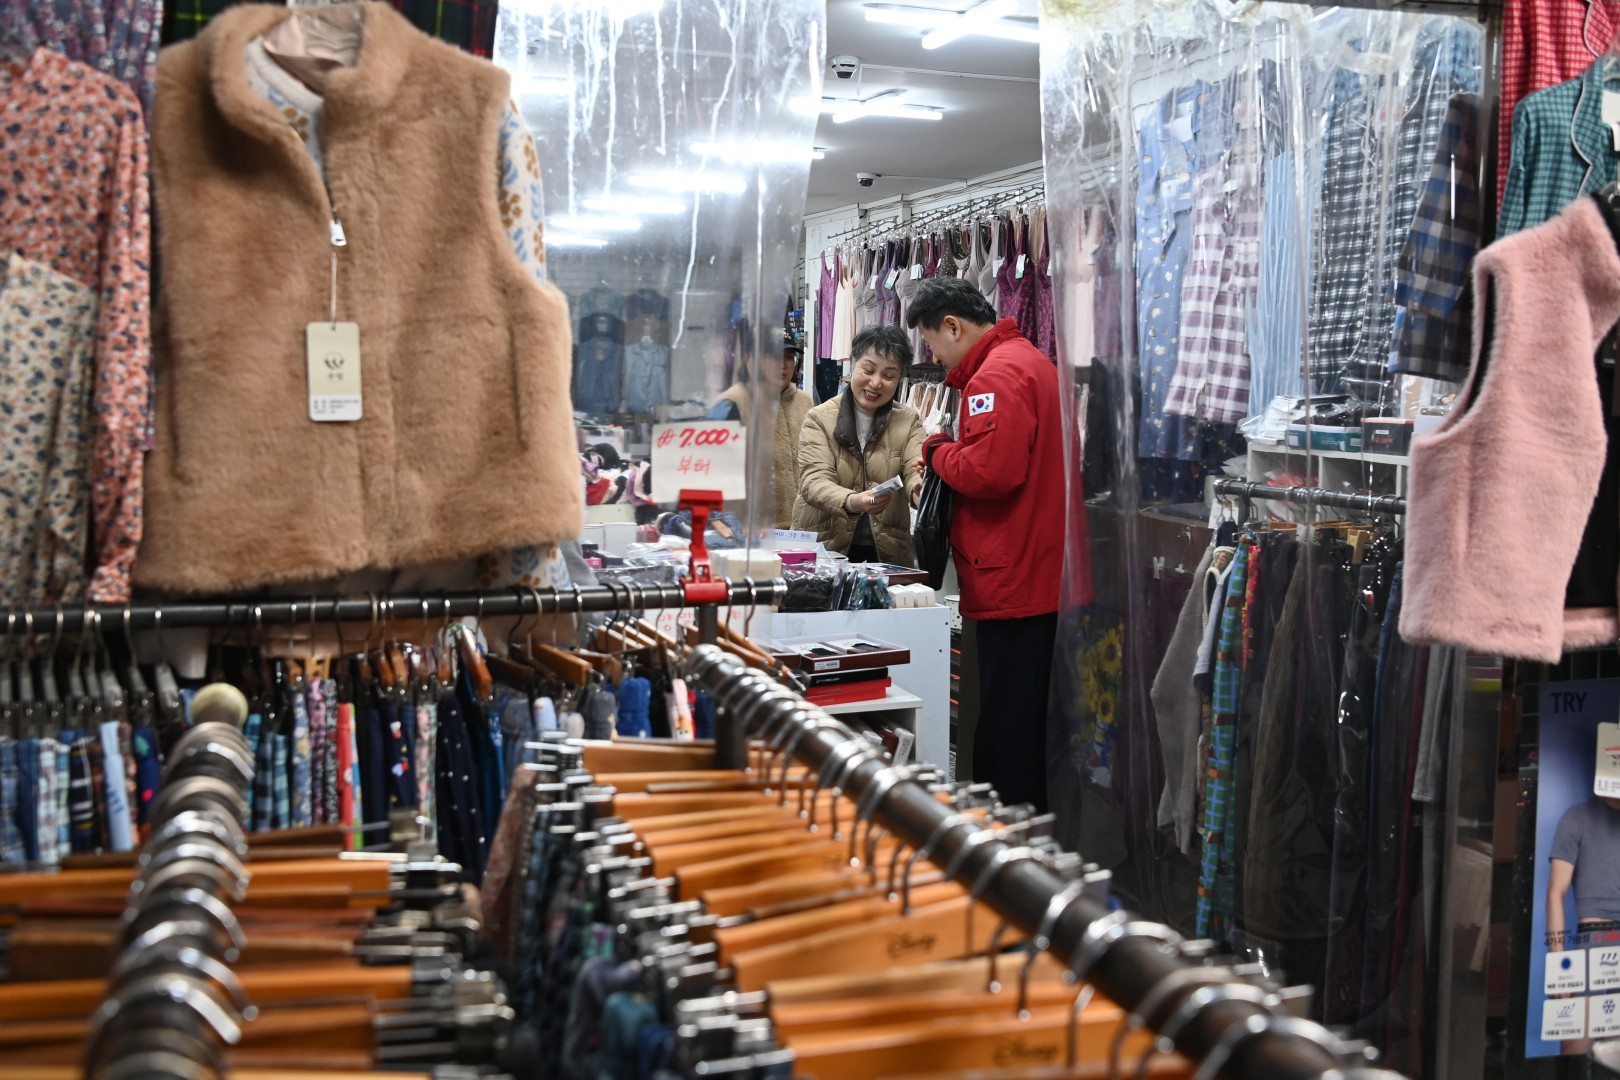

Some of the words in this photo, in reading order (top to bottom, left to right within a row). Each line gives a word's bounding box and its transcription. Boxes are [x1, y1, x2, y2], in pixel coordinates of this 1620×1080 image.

[677, 455, 711, 476] 부터
[1550, 691, 1588, 713] TRY
[886, 932, 936, 958] Disney
